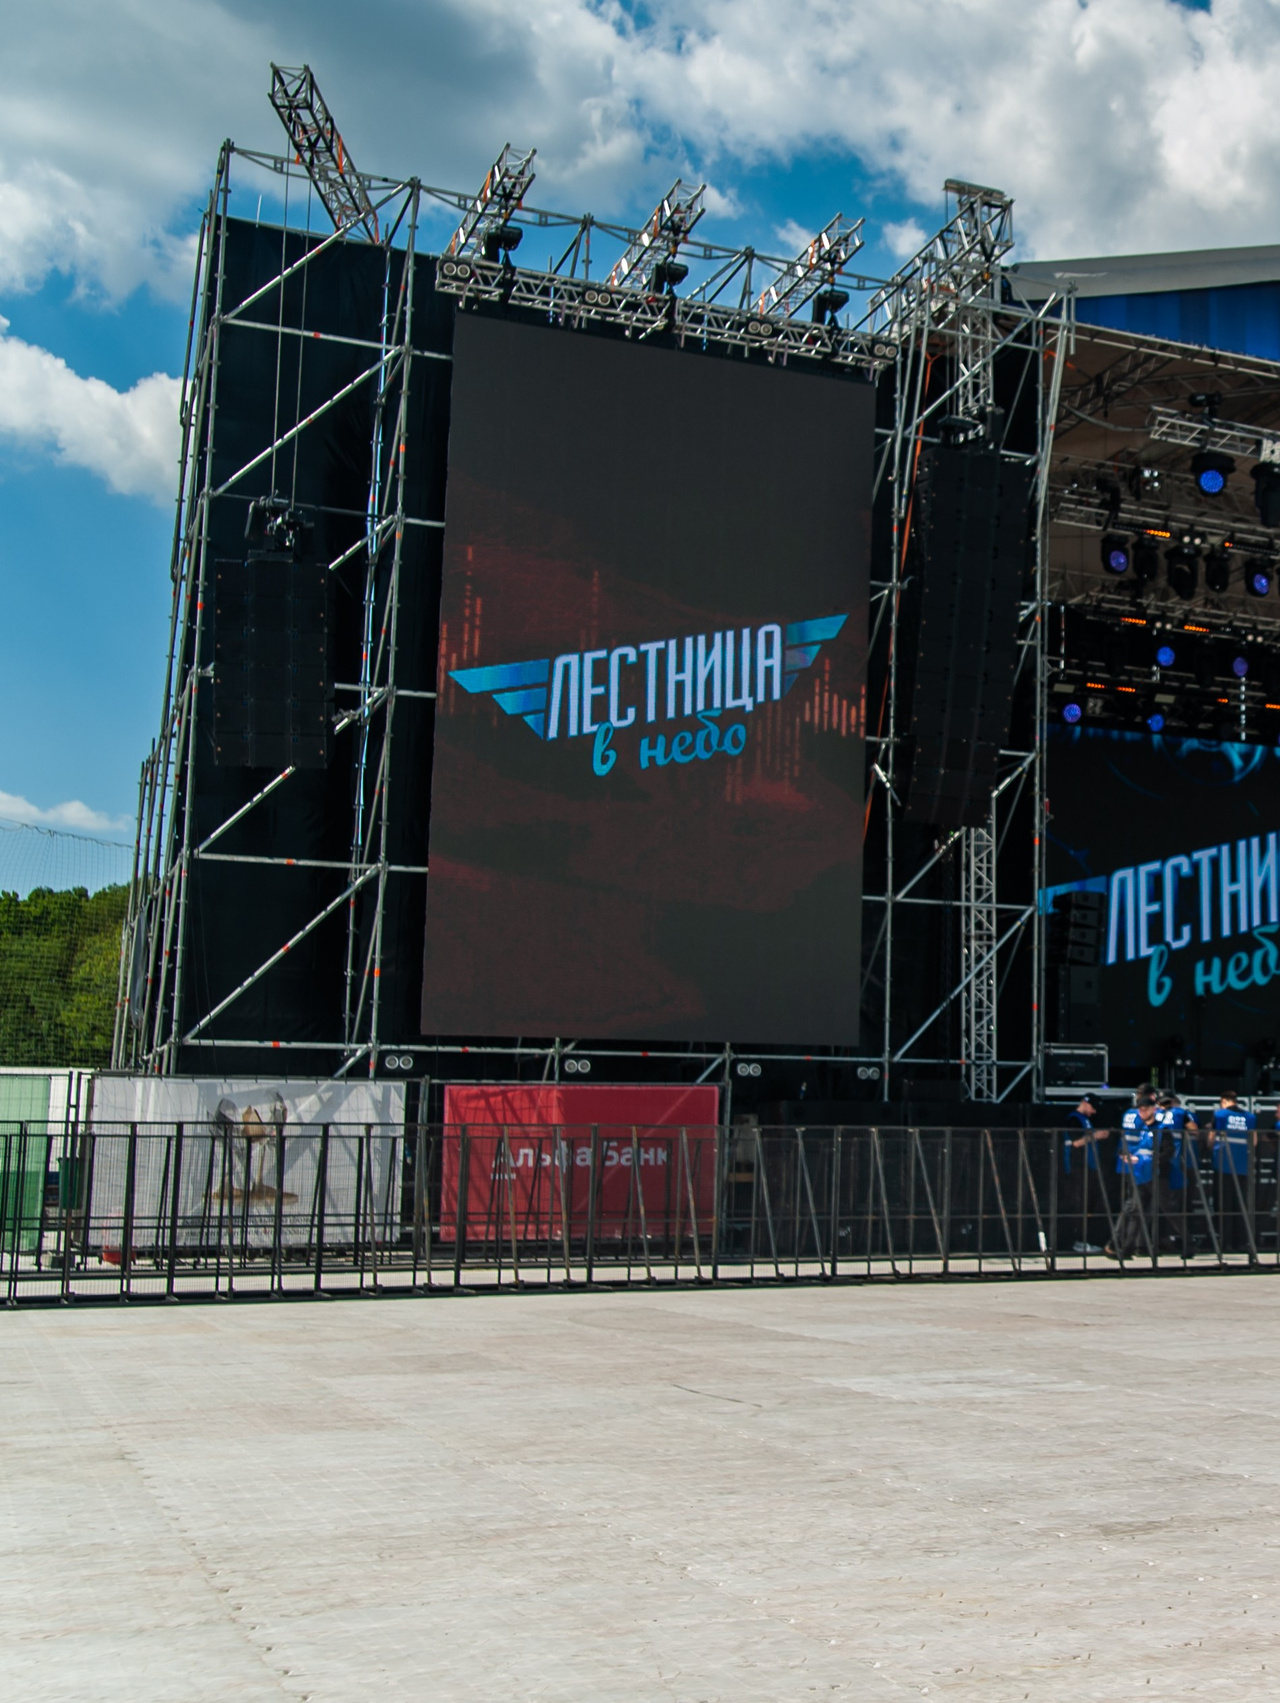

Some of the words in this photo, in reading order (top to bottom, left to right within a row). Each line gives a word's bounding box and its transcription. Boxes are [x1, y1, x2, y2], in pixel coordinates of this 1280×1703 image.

[548, 623, 783, 741] ЛЕСТНИЦА
[593, 721, 617, 777] в
[640, 710, 747, 769] небо
[1148, 945, 1173, 1007] в
